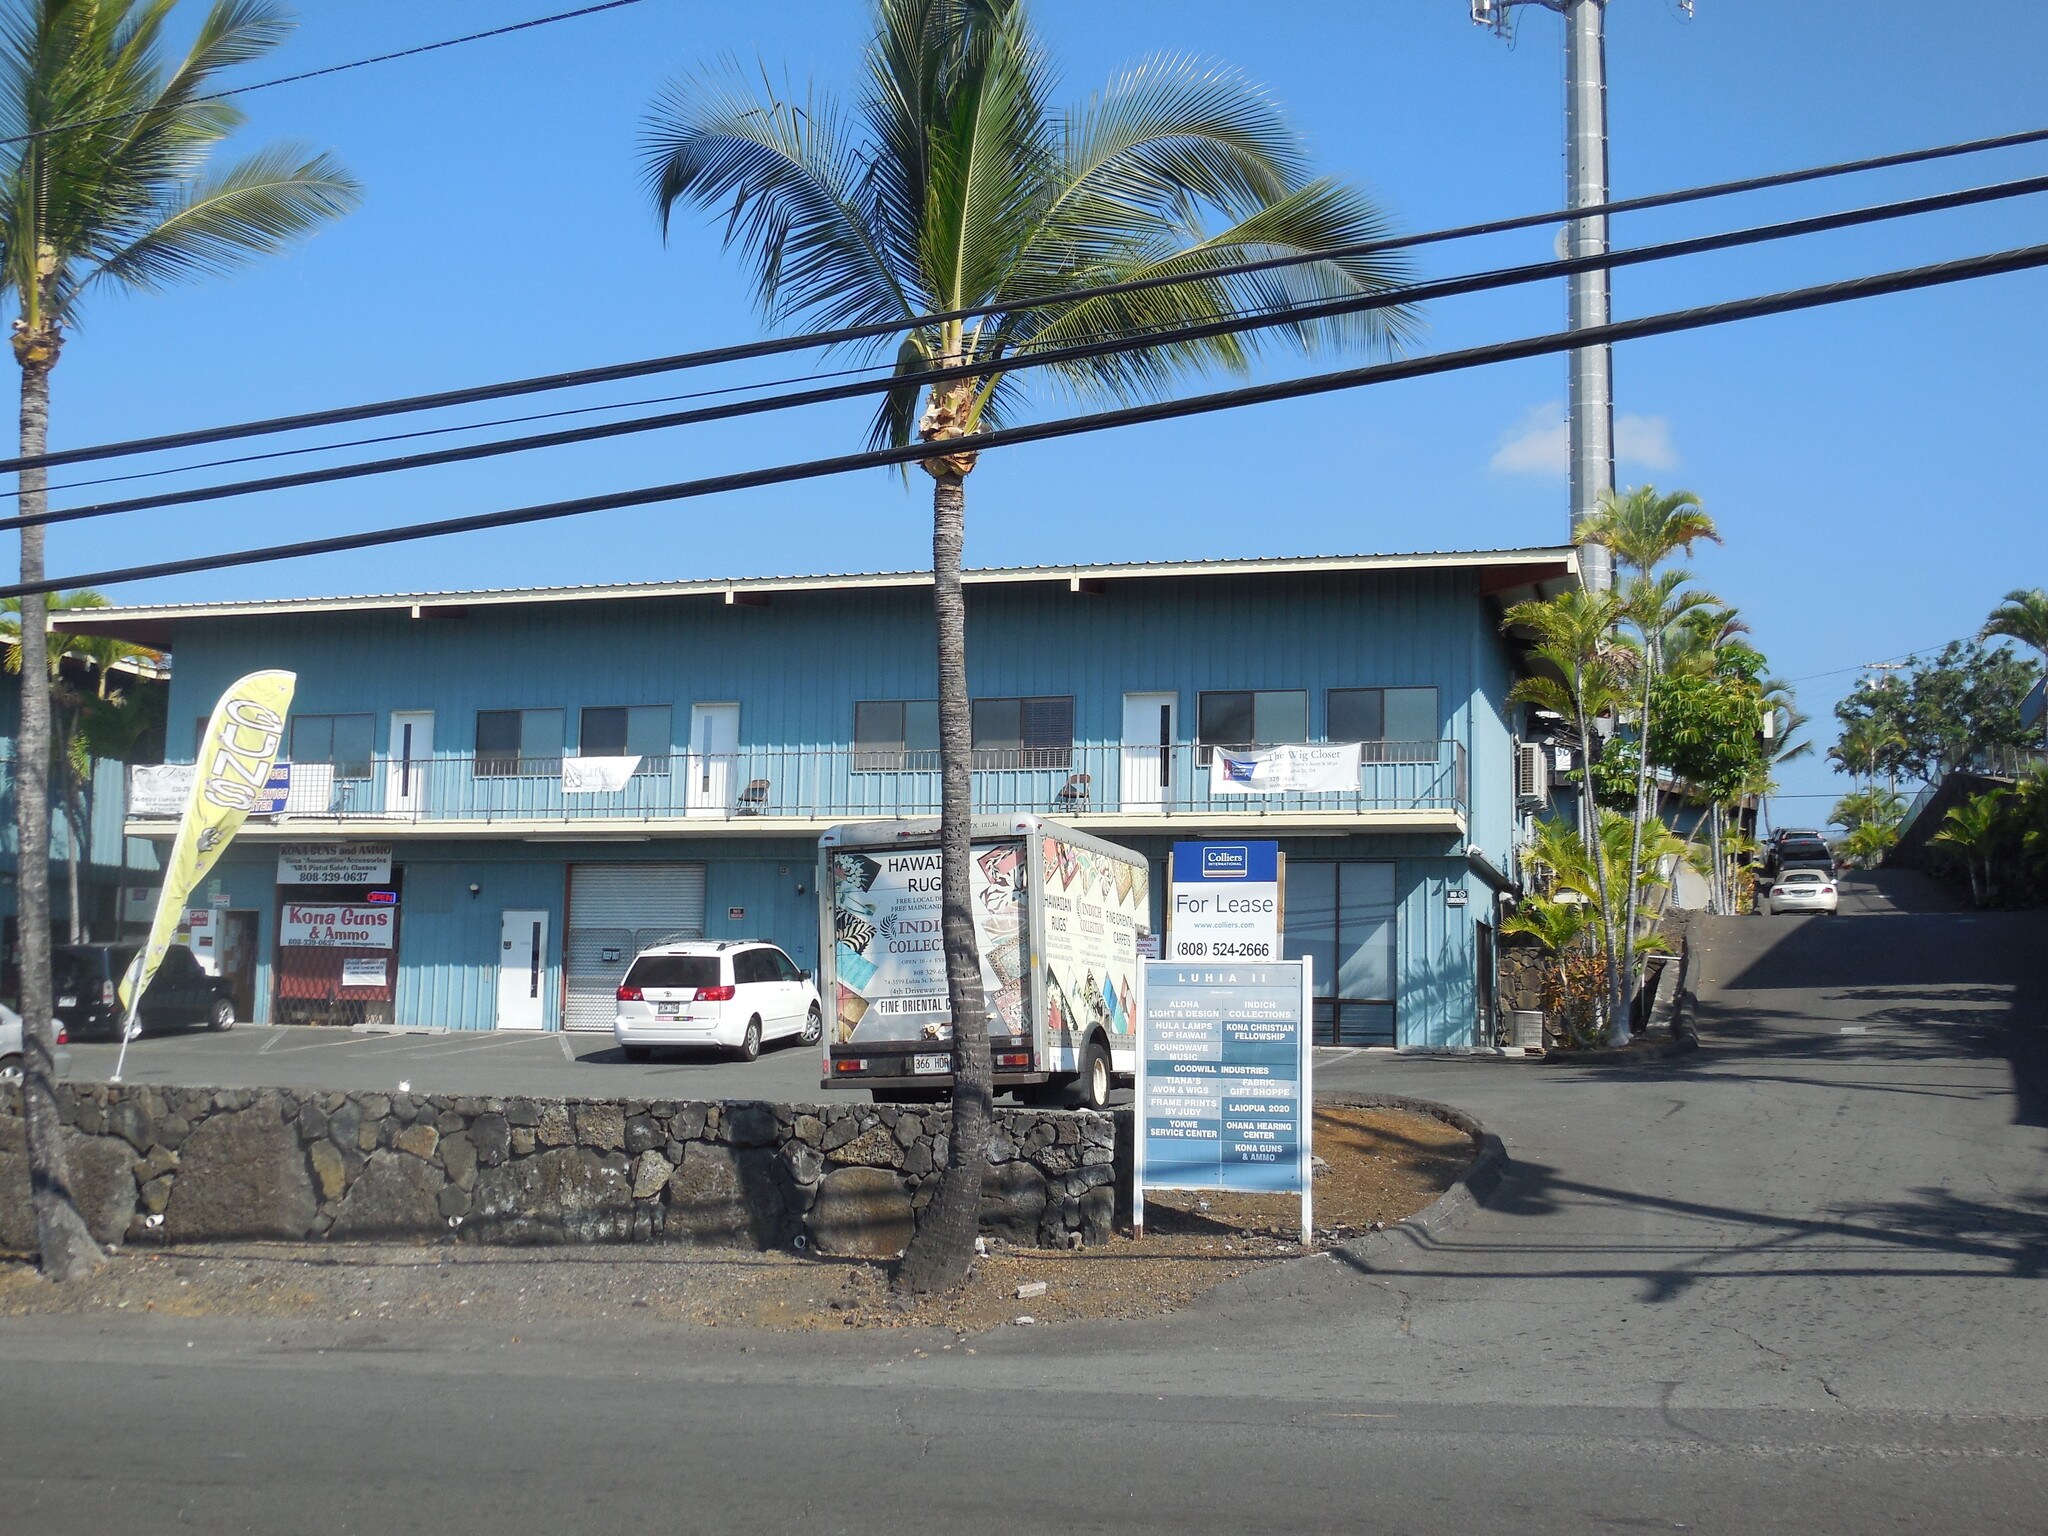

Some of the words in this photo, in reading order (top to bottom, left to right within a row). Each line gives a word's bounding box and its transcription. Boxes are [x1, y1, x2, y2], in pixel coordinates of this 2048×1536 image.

[1288, 750, 1308, 761] Wig
[1311, 749, 1340, 759] Closet
[269, 768, 288, 780] ORE
[1208, 852, 1243, 862] Colliers
[888, 855, 942, 873] HAWAI
[299, 872, 369, 882] 808-339-0637
[908, 876, 942, 892] RUG
[368, 893, 393, 901] OPEN
[1176, 894, 1209, 913] For
[1216, 894, 1274, 913] Lease
[288, 906, 336, 925] Kona
[340, 907, 388, 926] Guns
[898, 920, 940, 934] INDI
[1194, 921, 1255, 929] www.colliers.com
[309, 926, 320, 939] &
[324, 926, 370, 940] Ammo
[1177, 942, 1208, 957] (808)
[1212, 943, 1269, 957] 524-2666
[1178, 973, 1237, 983] LUHIA
[1251, 973, 1266, 983] II
[905, 987, 936, 995] Driveway
[880, 1000, 899, 1013] FINE
[902, 998, 942, 1012] ORIENTAL
[1244, 1001, 1276, 1009] INDICH
[1149, 1010, 1175, 1018] LIGHT
[1186, 1010, 1219, 1018] DESIGN
[1229, 1010, 1291, 1018] COLLECTIONS
[1182, 1022, 1213, 1030] LAMPS
[1226, 1023, 1249, 1031] KONA
[1250, 1024, 1294, 1032] CHRISTIAN
[1235, 1032, 1286, 1040] FELLOWSHIP
[1154, 1043, 1209, 1051] SOUNDWAVE
[1169, 1053, 1198, 1061] MUSIC
[915, 1058, 930, 1069] 366
[1174, 1065, 1217, 1073] GOODWILL
[1221, 1066, 1269, 1075] INDUSTRIES
[1166, 1077, 1201, 1085] TIANA'S
[1152, 1086, 1175, 1094] AVON
[1186, 1086, 1209, 1094] WIGS
[1230, 1088, 1251, 1096] GIFT
[1252, 1088, 1290, 1096] SHOPPE
[1184, 1099, 1217, 1107] PRINTS
[1178, 1108, 1201, 1116] JUDY
[1229, 1104, 1265, 1112] LAIOPUA
[1268, 1105, 1290, 1113] 2020
[1170, 1120, 1198, 1128] YOKWE
[1226, 1122, 1254, 1130] OHANA
[1257, 1122, 1292, 1130] HEARING
[1150, 1128, 1184, 1136] SERVICE
[1186, 1129, 1217, 1137] CENTER
[1243, 1131, 1275, 1139] CENTER
[1235, 1144, 1258, 1152] KONA
[1260, 1144, 1283, 1153] GUNS
[1250, 1153, 1276, 1161] AMMO
